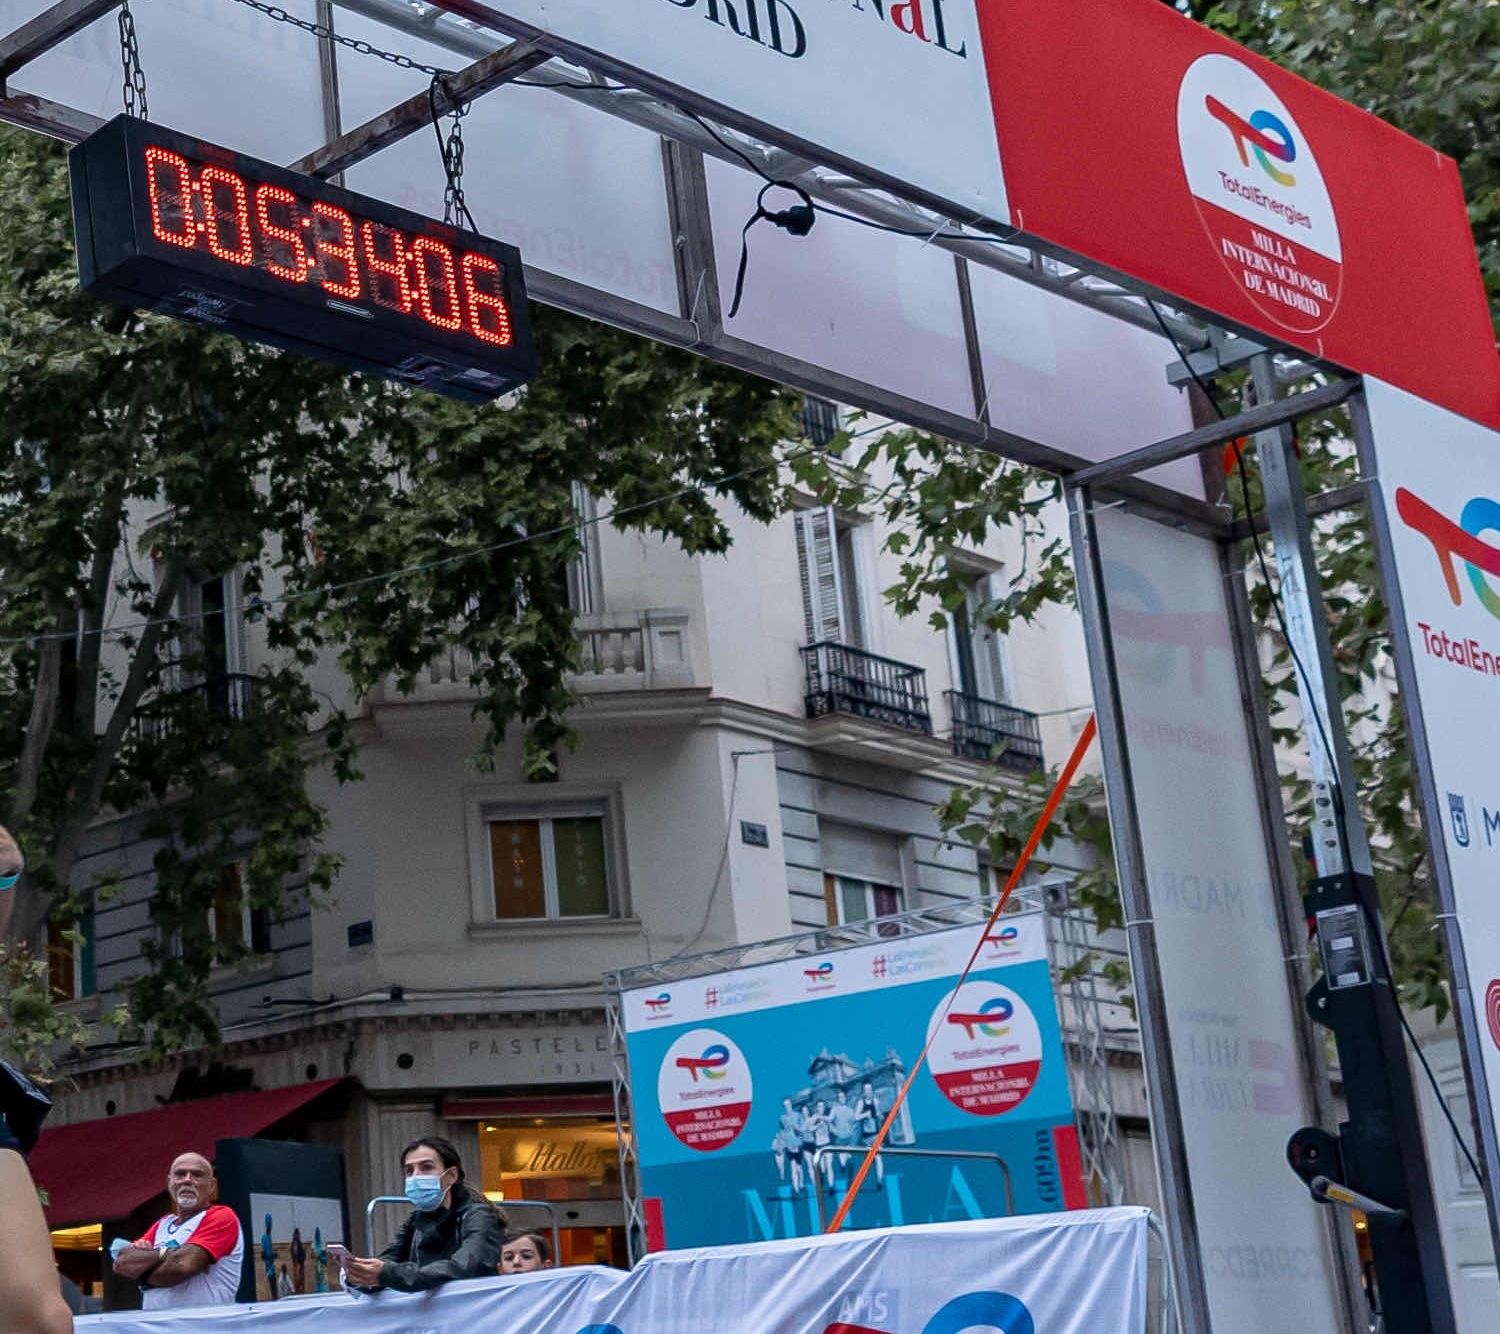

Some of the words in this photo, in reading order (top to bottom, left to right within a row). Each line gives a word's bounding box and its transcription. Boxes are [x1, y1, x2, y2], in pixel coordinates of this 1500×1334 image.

[1217, 170, 1312, 229] TotalEnergies
[1251, 230, 1297, 265] MILLA
[1244, 270, 1266, 294] DE
[1267, 282, 1320, 318] MADRID
